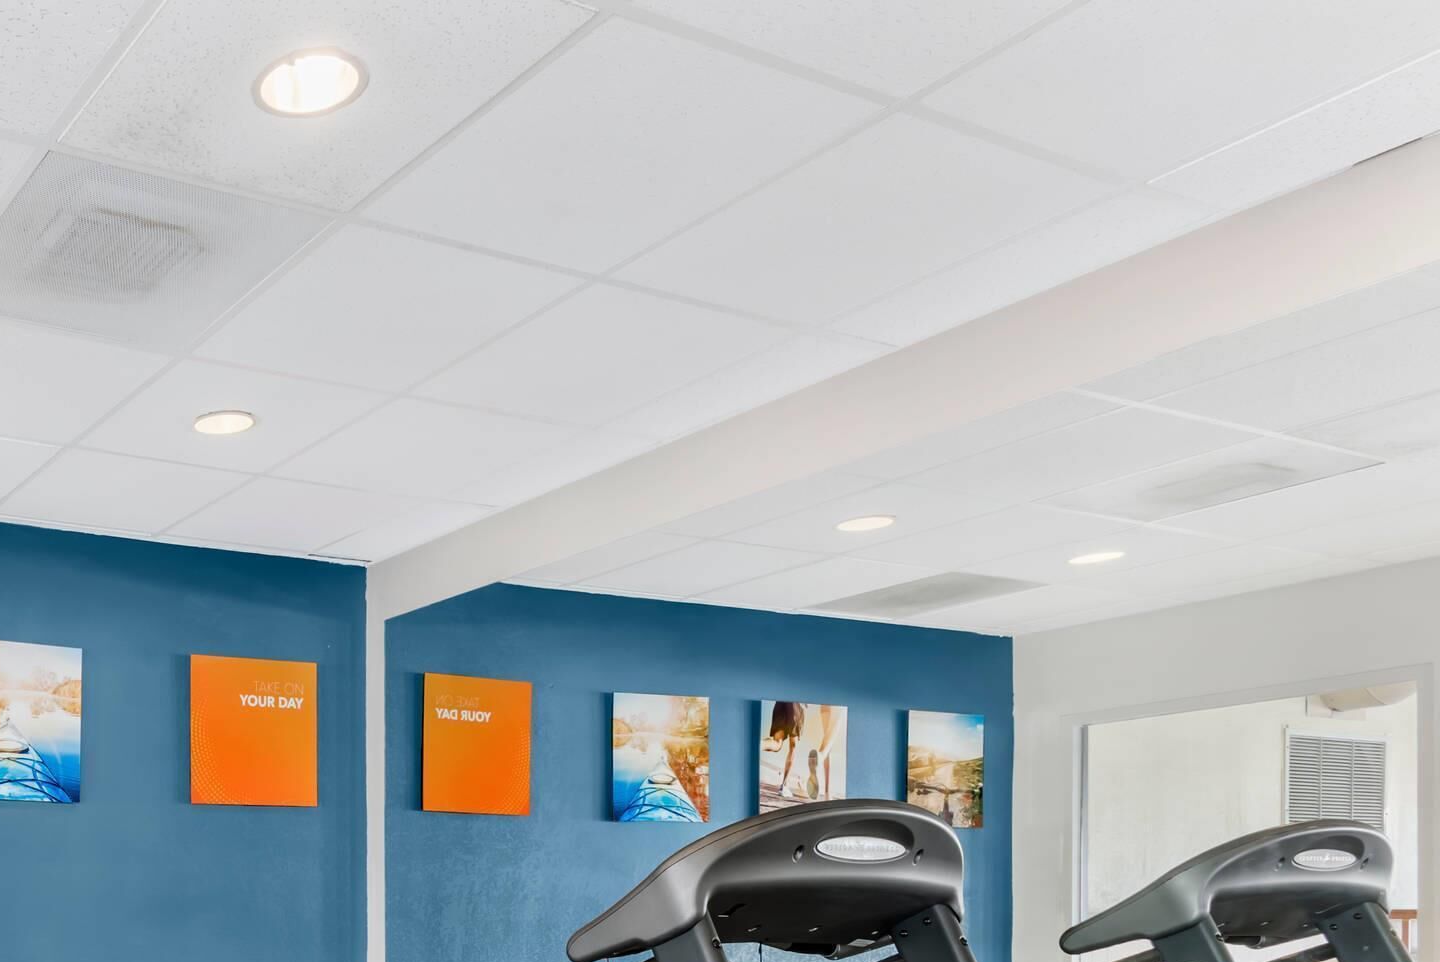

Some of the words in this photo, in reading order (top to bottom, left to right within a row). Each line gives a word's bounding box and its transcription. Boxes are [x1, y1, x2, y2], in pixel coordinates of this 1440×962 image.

[252, 680, 280, 695] TAKE
[285, 681, 305, 696] ON
[239, 694, 275, 708] YOUR
[278, 696, 304, 709] DAY
